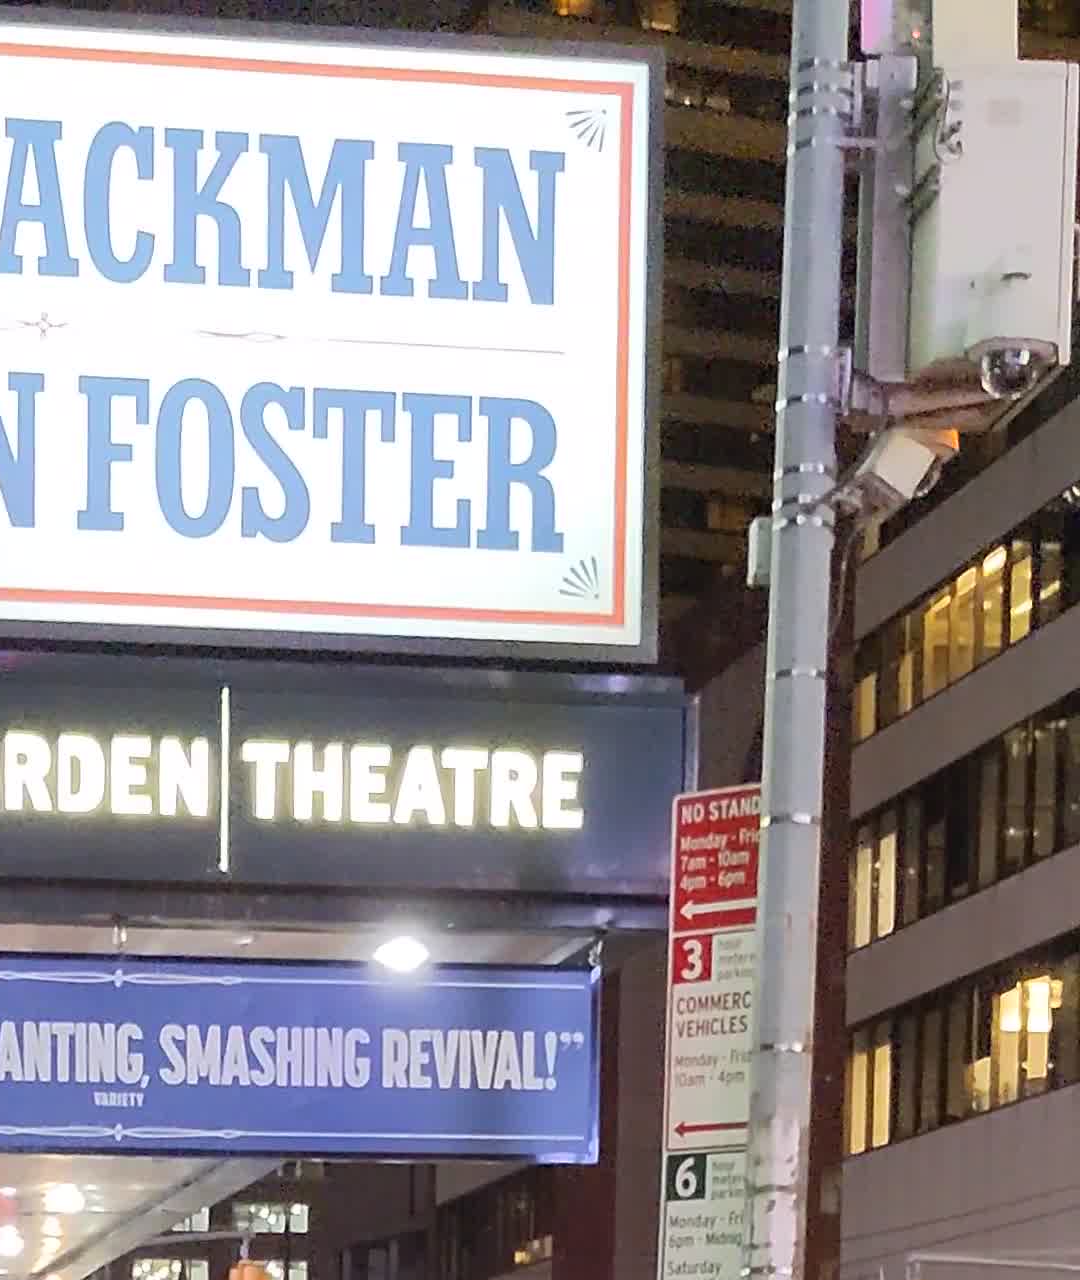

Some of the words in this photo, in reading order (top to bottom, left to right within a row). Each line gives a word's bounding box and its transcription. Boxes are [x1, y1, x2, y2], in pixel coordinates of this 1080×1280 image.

[77, 374, 564, 553] FOSTER
[242, 738, 586, 829] THEATRE
[680, 803, 705, 825] NO
[709, 796, 760, 821] STAND
[681, 938, 703, 981] 3
[676, 990, 752, 1016] COMMERC
[676, 1014, 749, 1039] VEHICLES
[158, 1023, 371, 1088] SMASHING
[381, 1026, 585, 1092] REVIVAL!”
[718, 1070, 746, 1087] 4pm
[93, 1092, 145, 1109] VARIETY
[675, 1157, 697, 1198] 6
[669, 1214, 717, 1231] Monday
[728, 1210, 745, 1226] Fri
[668, 1260, 722, 1278] Saturday
